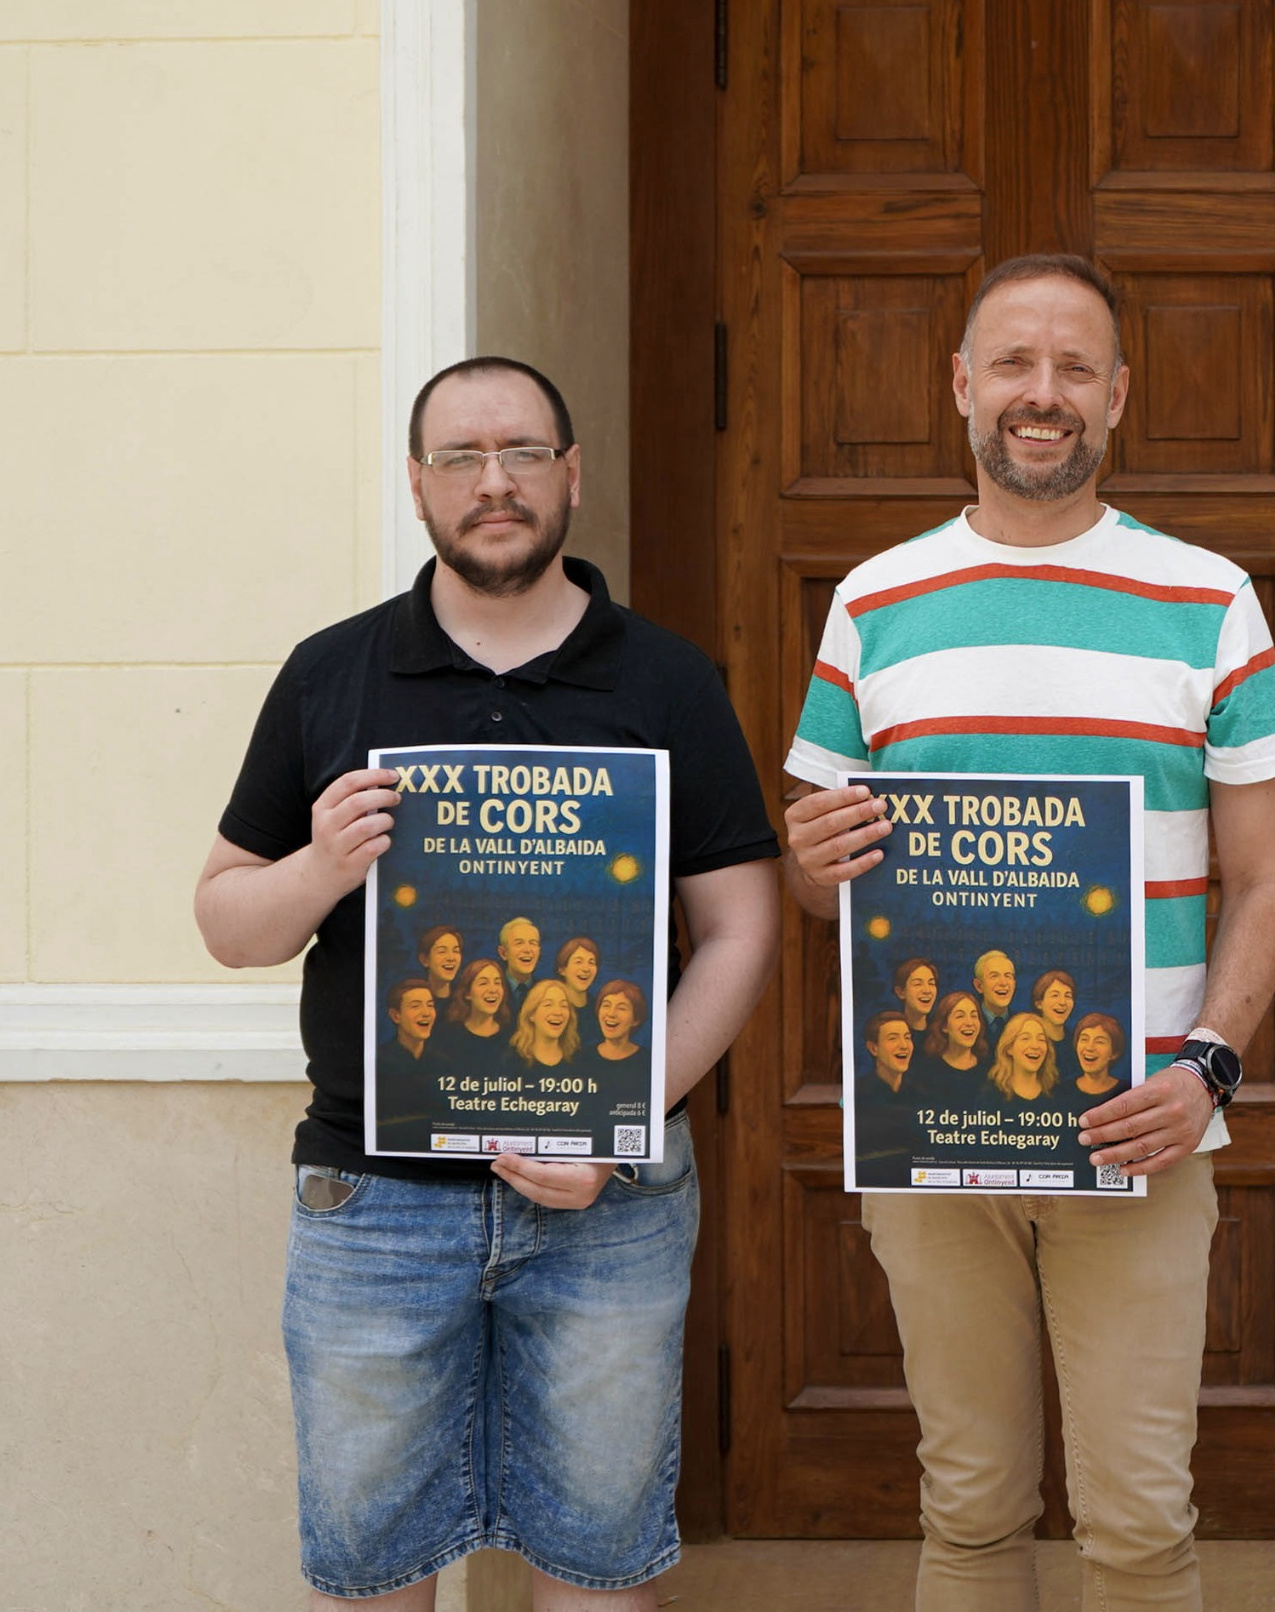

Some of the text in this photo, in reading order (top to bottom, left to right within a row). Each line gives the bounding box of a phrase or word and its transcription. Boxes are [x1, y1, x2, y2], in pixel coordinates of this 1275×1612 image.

[395, 765, 613, 796] XXX TROBADA
[438, 799, 581, 834] DE CORS
[943, 795, 1086, 827] TROBADA
[423, 838, 606, 856] DE LA VALL D'ALBAIDA
[909, 830, 1053, 866] DE CORS
[459, 860, 564, 875] ONTINYENT
[896, 869, 1080, 888] DE LA VALL D'ALBAIDA
[932, 892, 1037, 908] ONTINYENT
[438, 1077, 456, 1091] 12
[460, 1078, 479, 1092] de
[482, 1078, 522, 1095] juliol
[539, 1079, 582, 1094] 19:00
[588, 1079, 597, 1093] h
[448, 1096, 580, 1116] Teatre Echegaray
[917, 1110, 934, 1124] 12
[940, 1110, 958, 1125] de
[962, 1110, 1001, 1128] juliol
[1018, 1112, 1062, 1127] 19:00
[1068, 1113, 1077, 1127] h
[928, 1130, 1060, 1150] Teatre Echegaray
